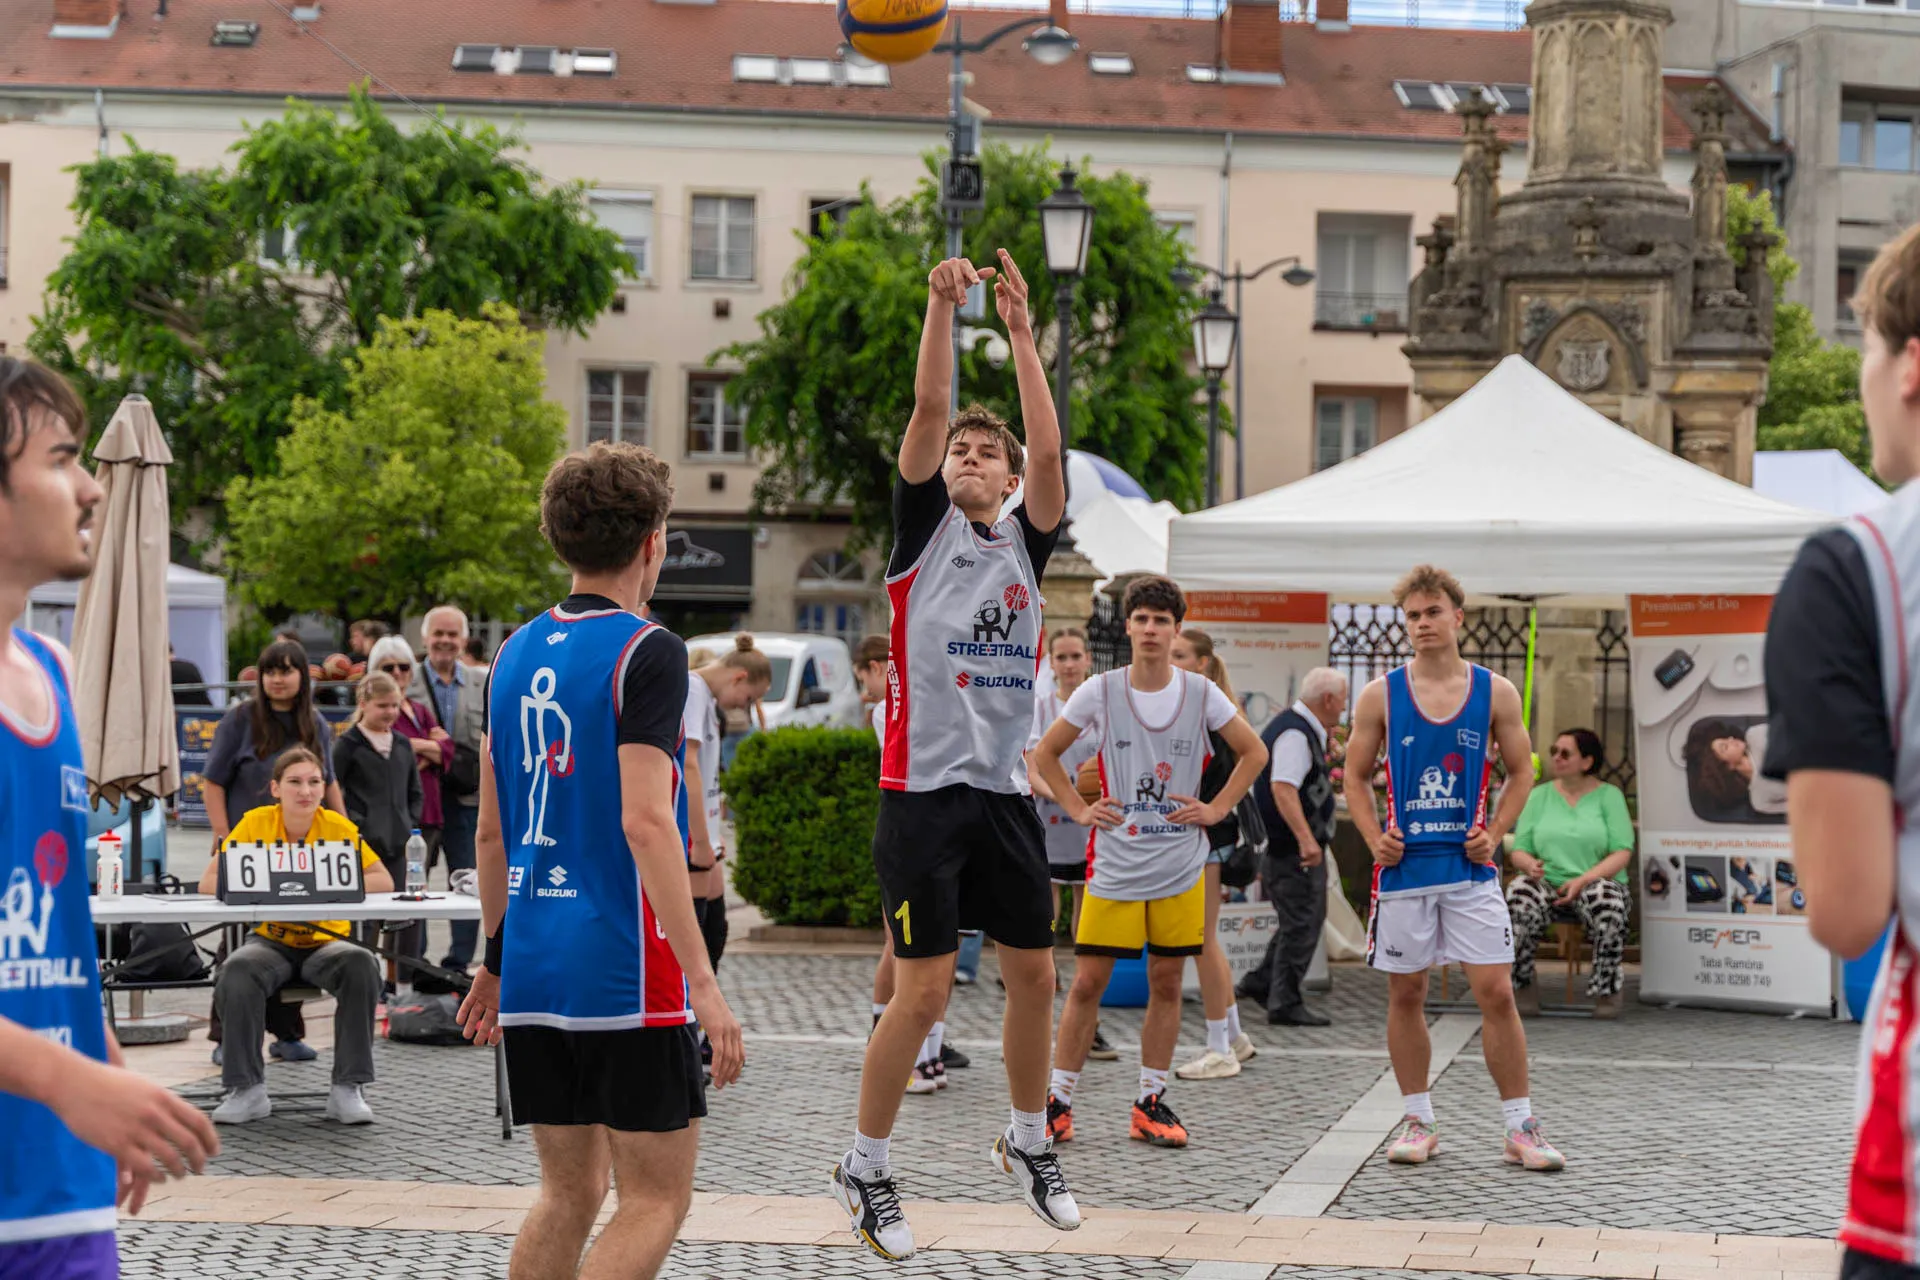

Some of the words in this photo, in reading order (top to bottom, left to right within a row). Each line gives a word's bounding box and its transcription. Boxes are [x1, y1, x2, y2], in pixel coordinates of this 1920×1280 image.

[947, 641, 1037, 660] STREETBAL
[973, 676, 1032, 690] SUZUKI
[1405, 797, 1466, 812] STREETBA
[1141, 824, 1187, 834] SUZUKI
[1424, 822, 1468, 832] SUZUK
[275, 851, 284, 870] 7
[297, 851, 308, 870] 0
[320, 852, 352, 886] 16
[240, 854, 256, 888] 6
[536, 888, 578, 898] SUZUKI
[895, 900, 912, 945] 1
[1687, 927, 1761, 948] BEMER
[0, 957, 88, 990] EETBALL
